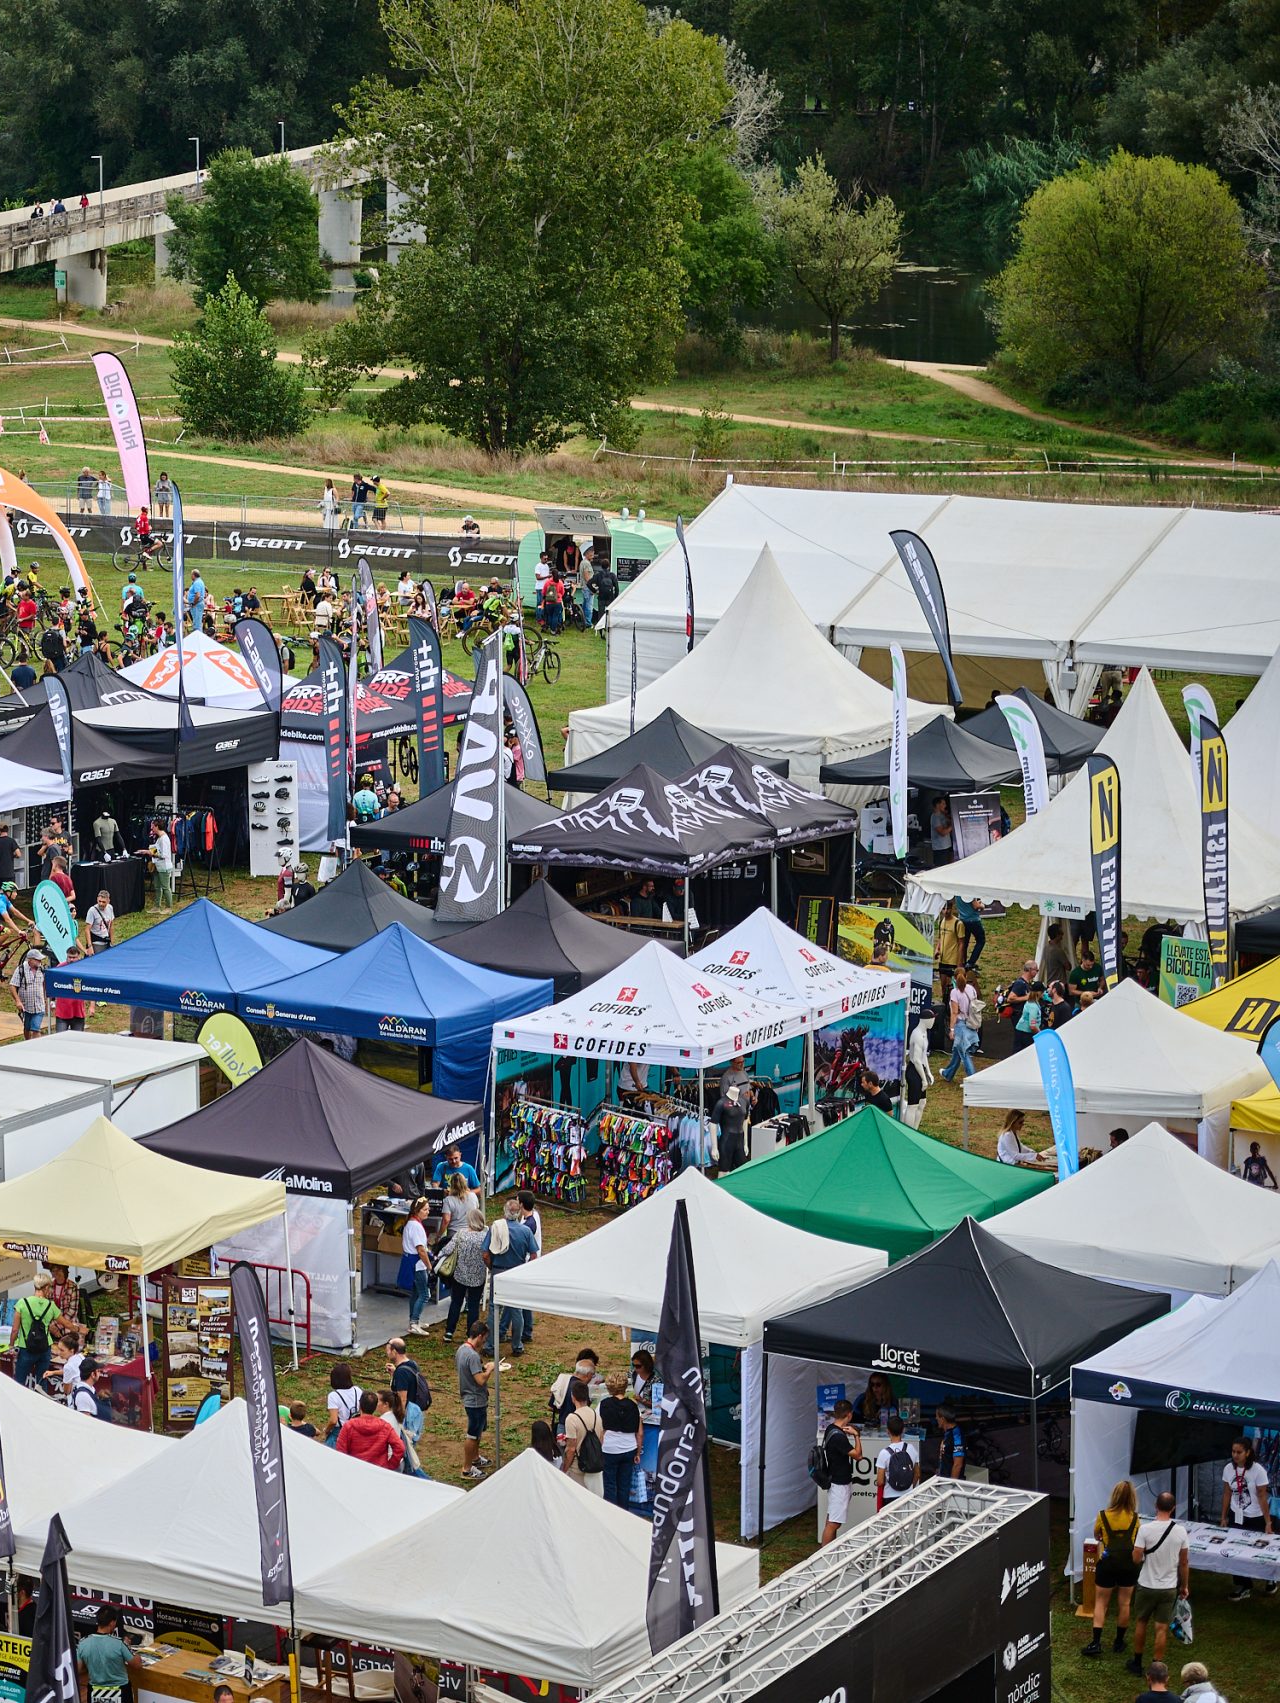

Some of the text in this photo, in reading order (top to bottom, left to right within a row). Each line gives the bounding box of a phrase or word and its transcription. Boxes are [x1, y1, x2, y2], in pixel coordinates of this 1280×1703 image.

[242, 537, 306, 551] SCOTT
[353, 545, 416, 558] SCOTT
[372, 672, 410, 686] PRO
[282, 698, 323, 714] RIDE
[80, 768, 114, 782] Q36.5
[1167, 944, 1194, 958] LLEVATE
[703, 963, 757, 981] COFIDES
[805, 961, 836, 978] COFIDES
[1165, 958, 1211, 979] BICICLETA
[53, 981, 73, 990] Conselh
[179, 996, 194, 1005] VAL
[851, 984, 887, 1009] COFIDES
[246, 1006, 266, 1015] Conselh
[588, 1002, 647, 1017] COFIDES
[697, 994, 733, 1015] COFIDES
[379, 1022, 394, 1032] VAL
[745, 1021, 784, 1047] COFIDES
[574, 1036, 648, 1057] COFIDES
[880, 1342, 921, 1366] lloret
[897, 1363, 921, 1373] de mar
[1193, 1404, 1256, 1418] CAVALLS 360
[1016, 1561, 1029, 1576] PAL
[1017, 1561, 1046, 1587] ARINSAL
[156, 1611, 182, 1623] Hotansa
